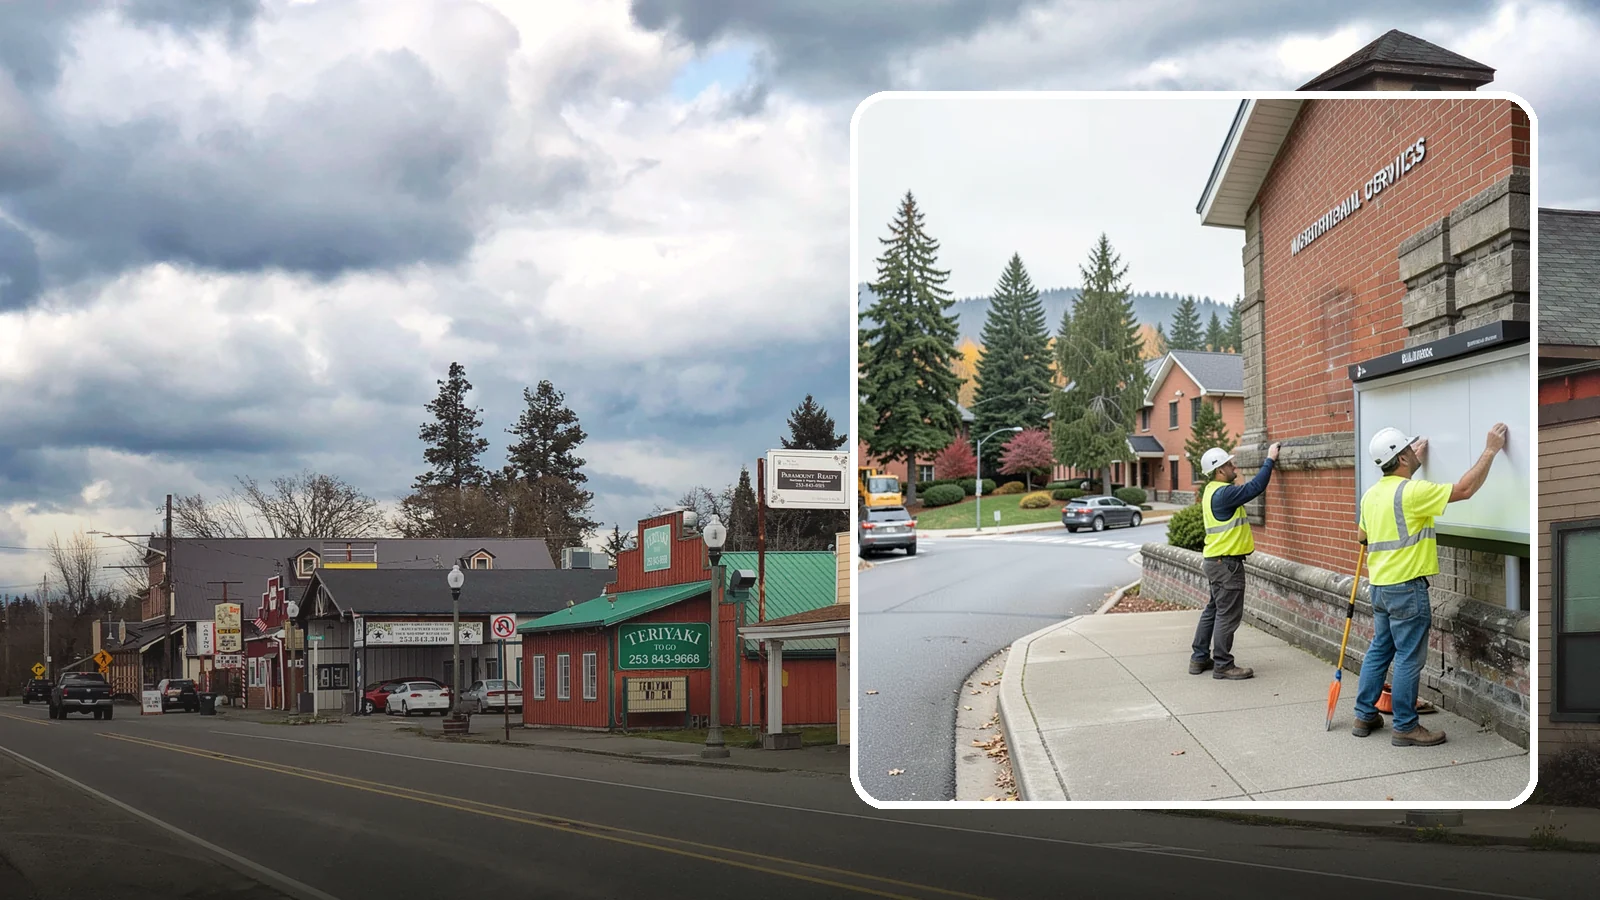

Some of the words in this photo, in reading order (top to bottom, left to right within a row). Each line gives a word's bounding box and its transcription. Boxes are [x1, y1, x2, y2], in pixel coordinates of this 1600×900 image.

[624, 627, 702, 646] TERIYAKI
[628, 654, 648, 665] 253
[651, 654, 700, 664] 843-9668
